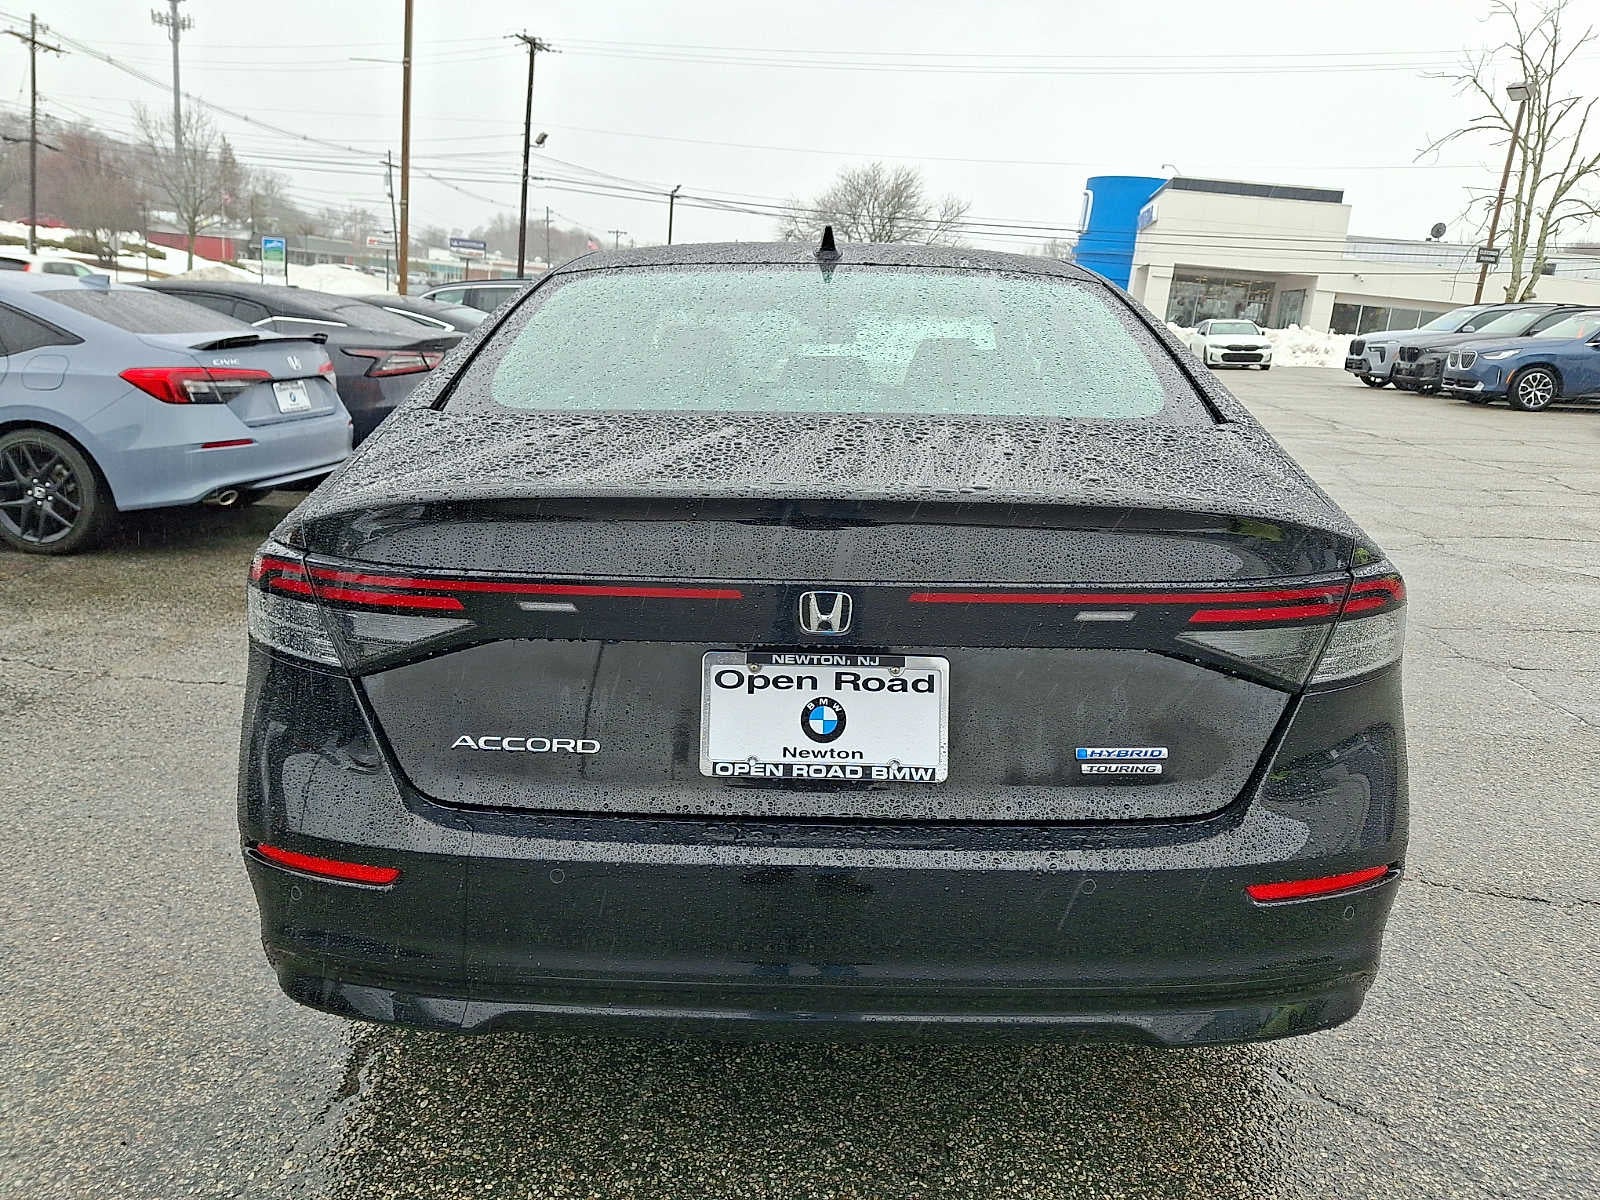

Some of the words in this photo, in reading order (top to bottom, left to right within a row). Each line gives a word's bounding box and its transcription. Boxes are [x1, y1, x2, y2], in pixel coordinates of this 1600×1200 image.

[212, 358, 240, 366] CIVIC
[771, 653, 851, 666] NEWTON,
[857, 655, 881, 666] NJ
[714, 669, 818, 695] Open
[834, 671, 936, 694] Road
[806, 698, 843, 713] BMW
[450, 735, 601, 754] ACCORD
[782, 746, 864, 760] Newton
[1089, 749, 1163, 758] HYBRID
[715, 762, 784, 777] OPEN
[792, 764, 863, 779] ROAD
[871, 766, 933, 781] BMW
[1087, 765, 1157, 773] TOURING
